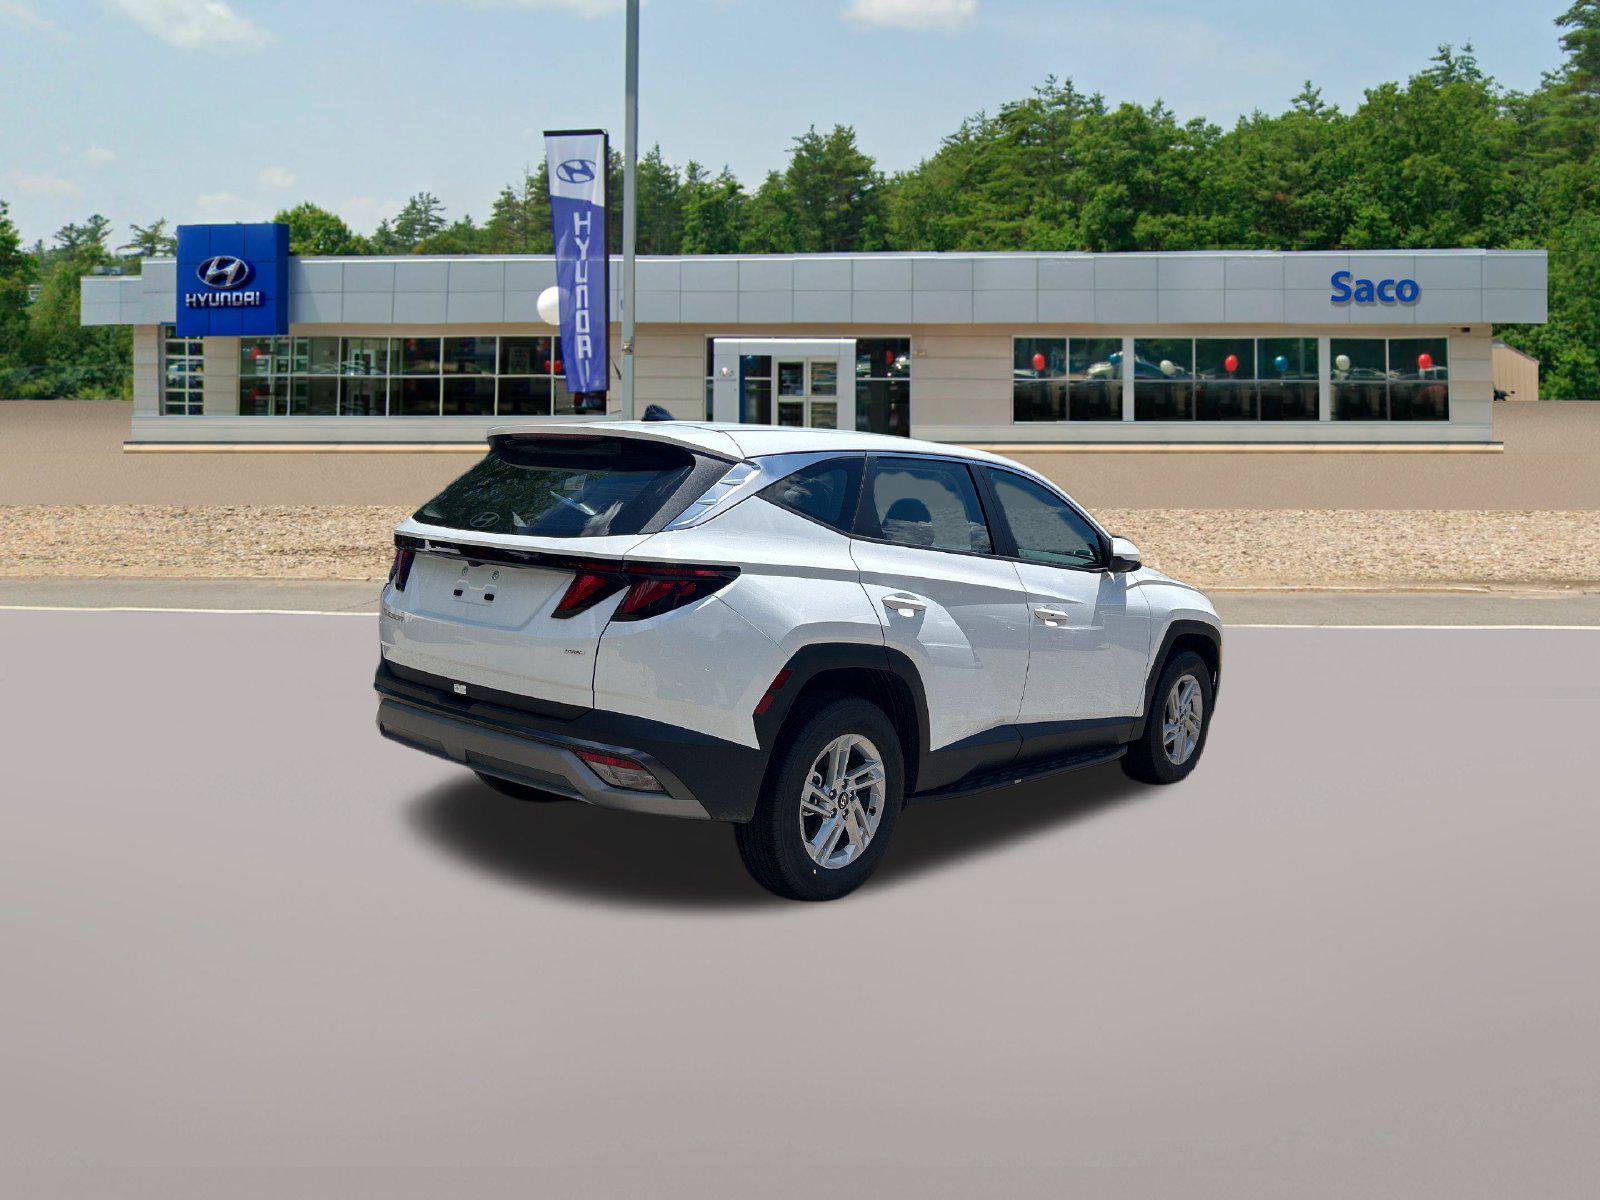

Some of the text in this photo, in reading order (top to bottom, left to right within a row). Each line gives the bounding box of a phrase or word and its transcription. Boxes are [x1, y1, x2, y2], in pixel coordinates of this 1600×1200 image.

[185, 291, 260, 307] HYUNDAI
[573, 211, 592, 386] HYUNDAI
[1330, 270, 1420, 303] Saco
